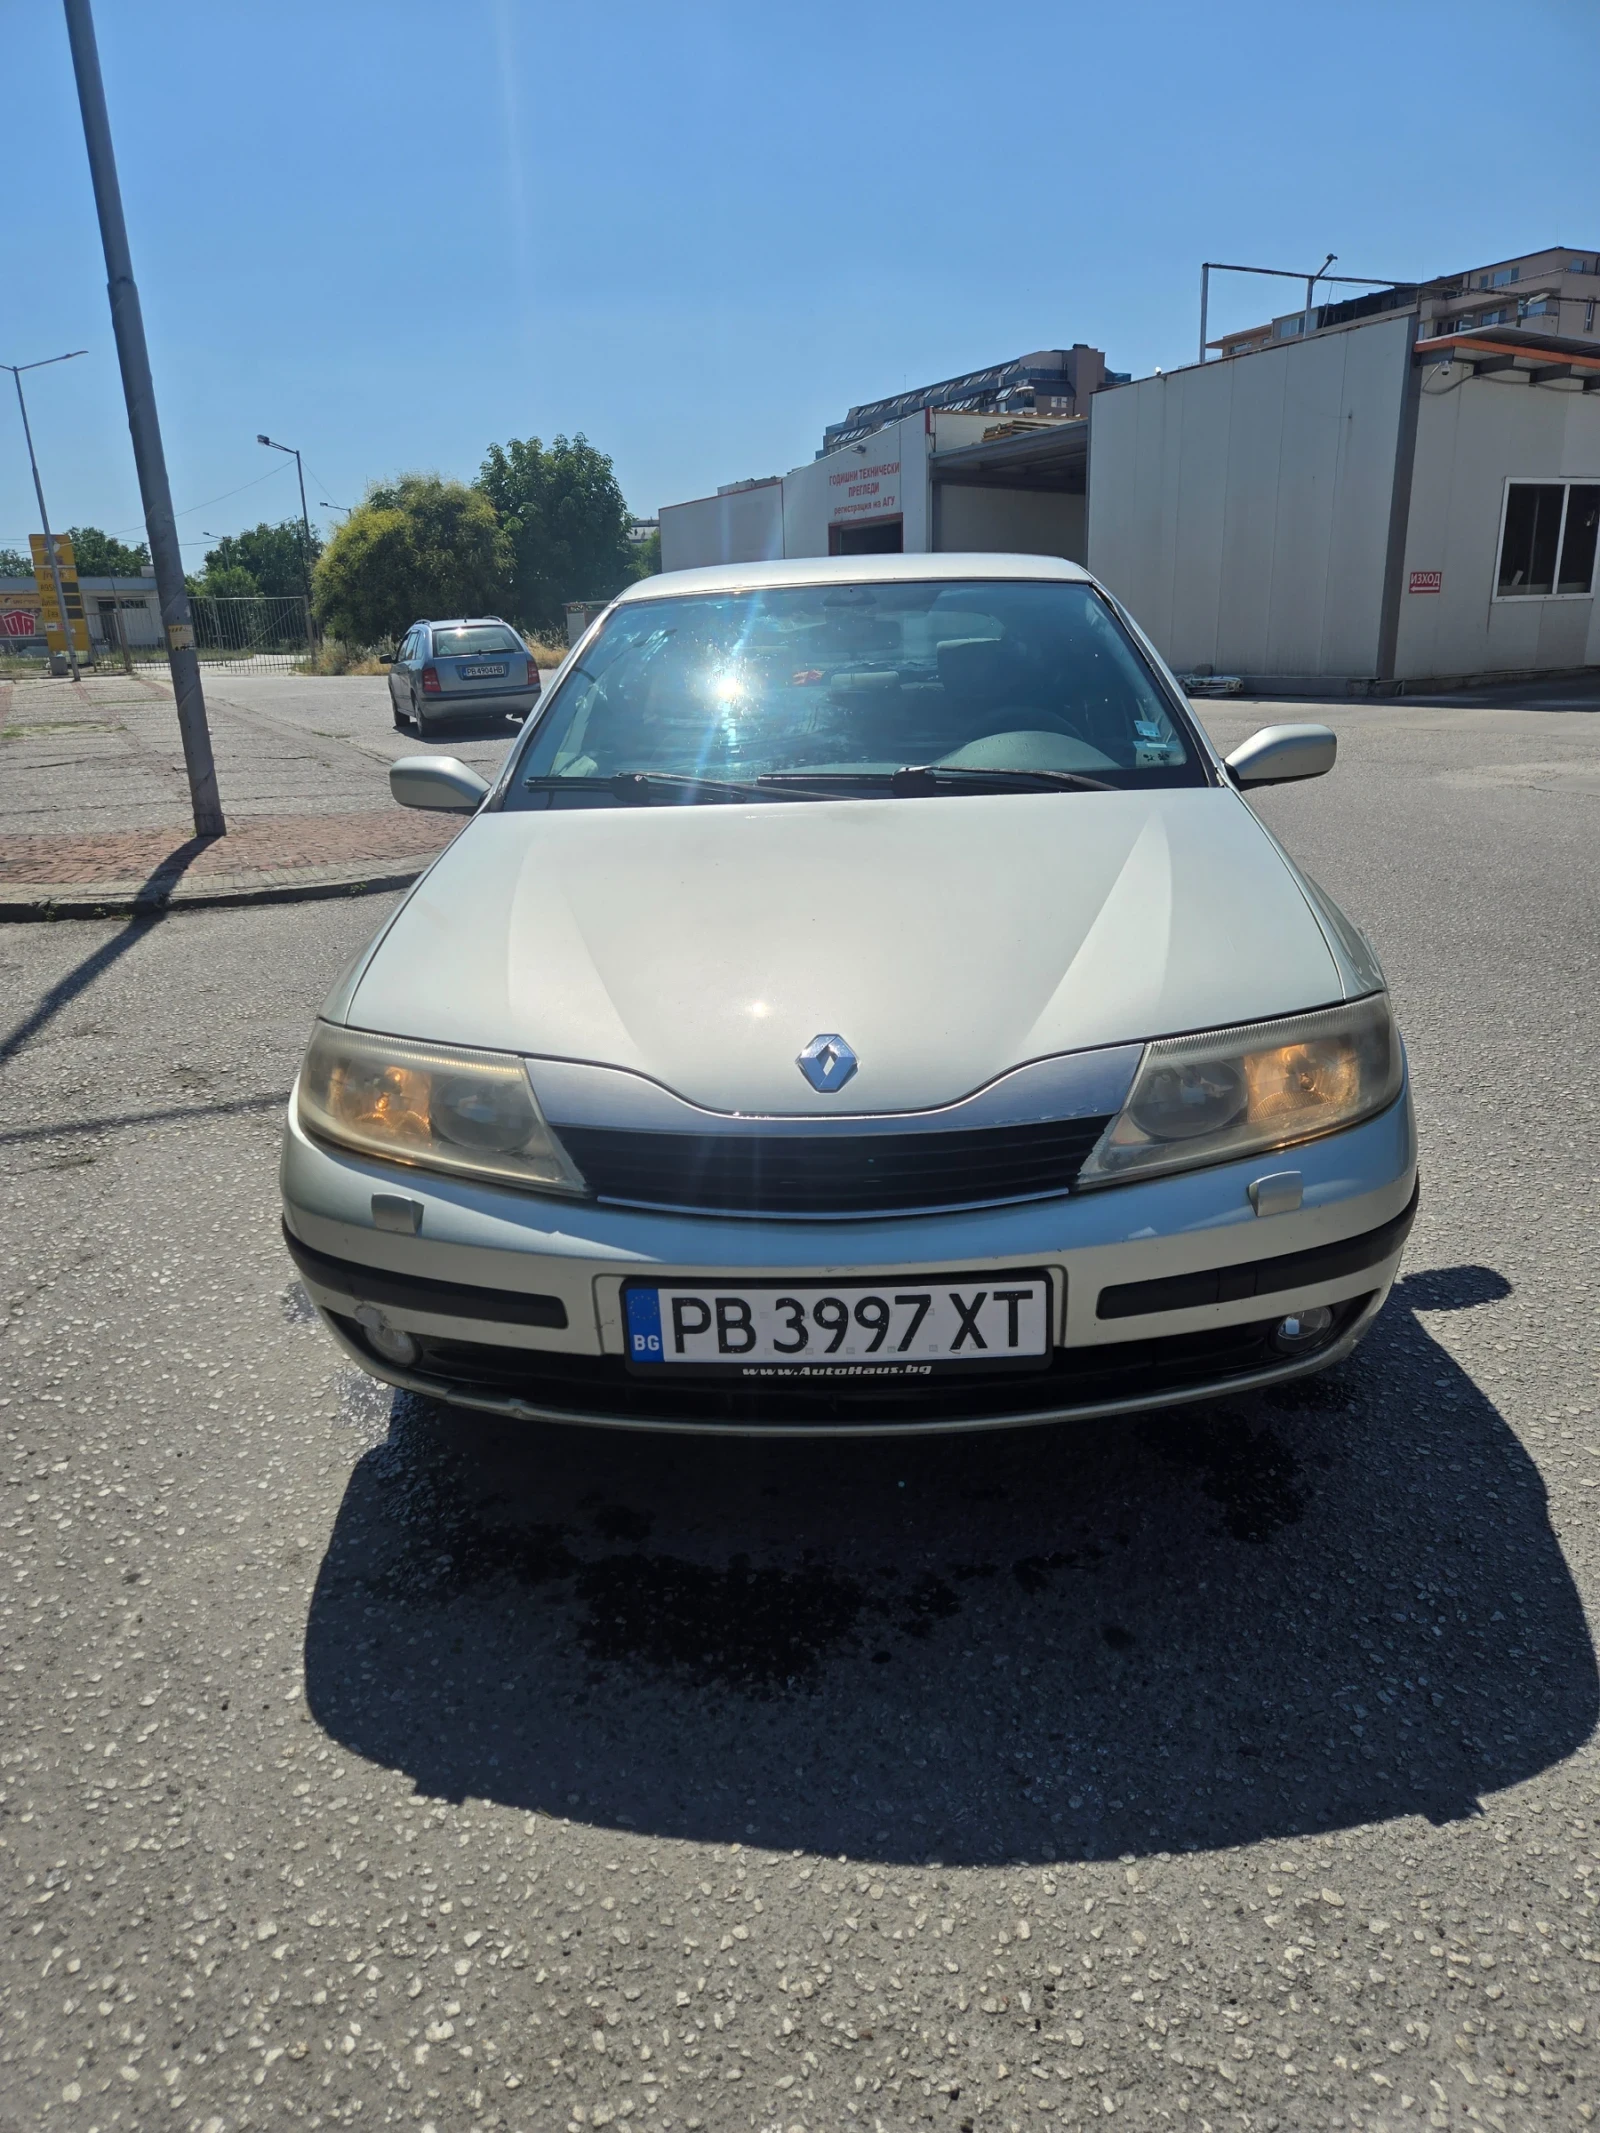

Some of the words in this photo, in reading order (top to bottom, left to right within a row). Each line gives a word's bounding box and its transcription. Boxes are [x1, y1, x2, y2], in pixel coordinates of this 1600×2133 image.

[829, 470, 858, 486] ГОДИШНИ
[859, 462, 900, 480] ТЕХНИЧЕСКИ
[848, 482, 880, 498] ПРЕГЛЕДИ
[834, 502, 872, 516] регистрация
[873, 500, 881, 509] на
[882, 496, 895, 507] АГУ
[1410, 573, 1441, 586] ИЗХОД
[671, 1297, 757, 1355] PB
[773, 1294, 932, 1354] 3997
[948, 1289, 1034, 1350] XT
[633, 1333, 660, 1351] BG
[742, 1364, 932, 1377] www.AutoHaus.bg
